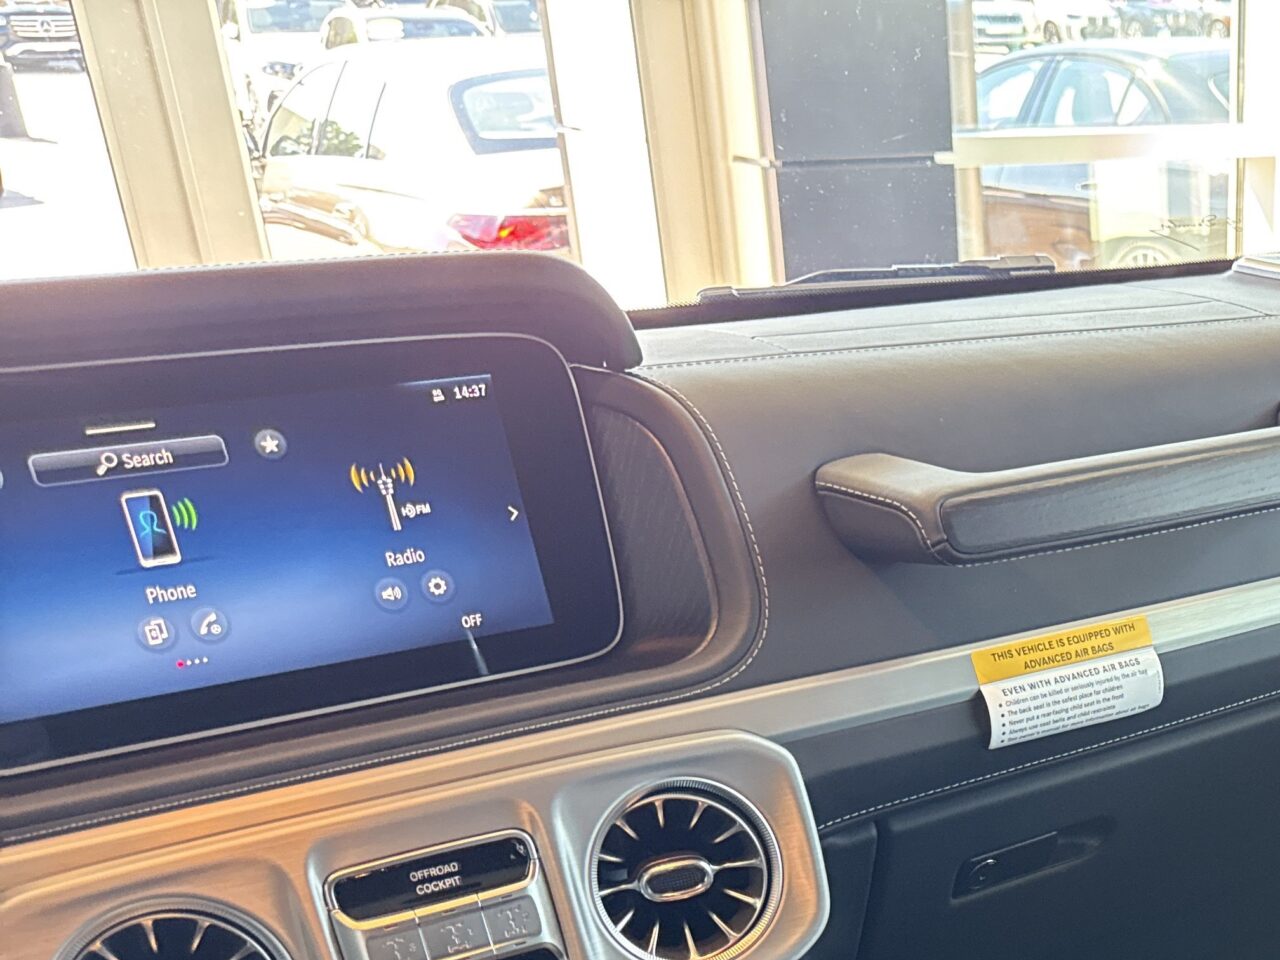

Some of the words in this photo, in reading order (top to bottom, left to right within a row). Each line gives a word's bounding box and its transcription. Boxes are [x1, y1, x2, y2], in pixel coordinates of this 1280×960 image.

[453, 383, 486, 400] 14:37
[122, 448, 173, 469] Search
[385, 548, 425, 567] Radio
[145, 584, 197, 604] Phone
[461, 613, 482, 628] OFF
[991, 649, 1014, 662] THIS
[1015, 640, 1055, 656] VEHICLE
[1056, 638, 1066, 648] IS
[1066, 628, 1111, 646] EQUIPPED
[1112, 623, 1136, 635] WITH
[1024, 651, 1073, 670] ADVANCED
[1074, 647, 1089, 658] AIR
[1091, 642, 1115, 655] BAGS
[1001, 684, 1026, 697] EVEN
[1027, 679, 1052, 690] WITH
[1053, 667, 1100, 684] ADVANCED
[1102, 663, 1117, 673] AIR
[1118, 658, 1141, 669] BAGS
[1005, 697, 1029, 707] Children
[1048, 688, 1064, 697] killed
[1071, 682, 1094, 692] seriously
[1095, 676, 1114, 686] injured
[1019, 706, 1032, 714] back
[1033, 703, 1045, 711] seat
[1061, 695, 1078, 704] safest
[1078, 692, 1093, 700] place
[1102, 685, 1123, 694] children
[1008, 718, 1025, 726] Never
[1025, 715, 1035, 723] put
[1083, 700, 1095, 708] seat
[1008, 726, 1028, 735] Always
[1040, 720, 1051, 728] seat
[1052, 716, 1065, 724] belts
[1066, 713, 1077, 721] and
[1077, 710, 1090, 718] child
[409, 862, 459, 882] OFFROAD
[416, 876, 461, 896] COCKPIT
